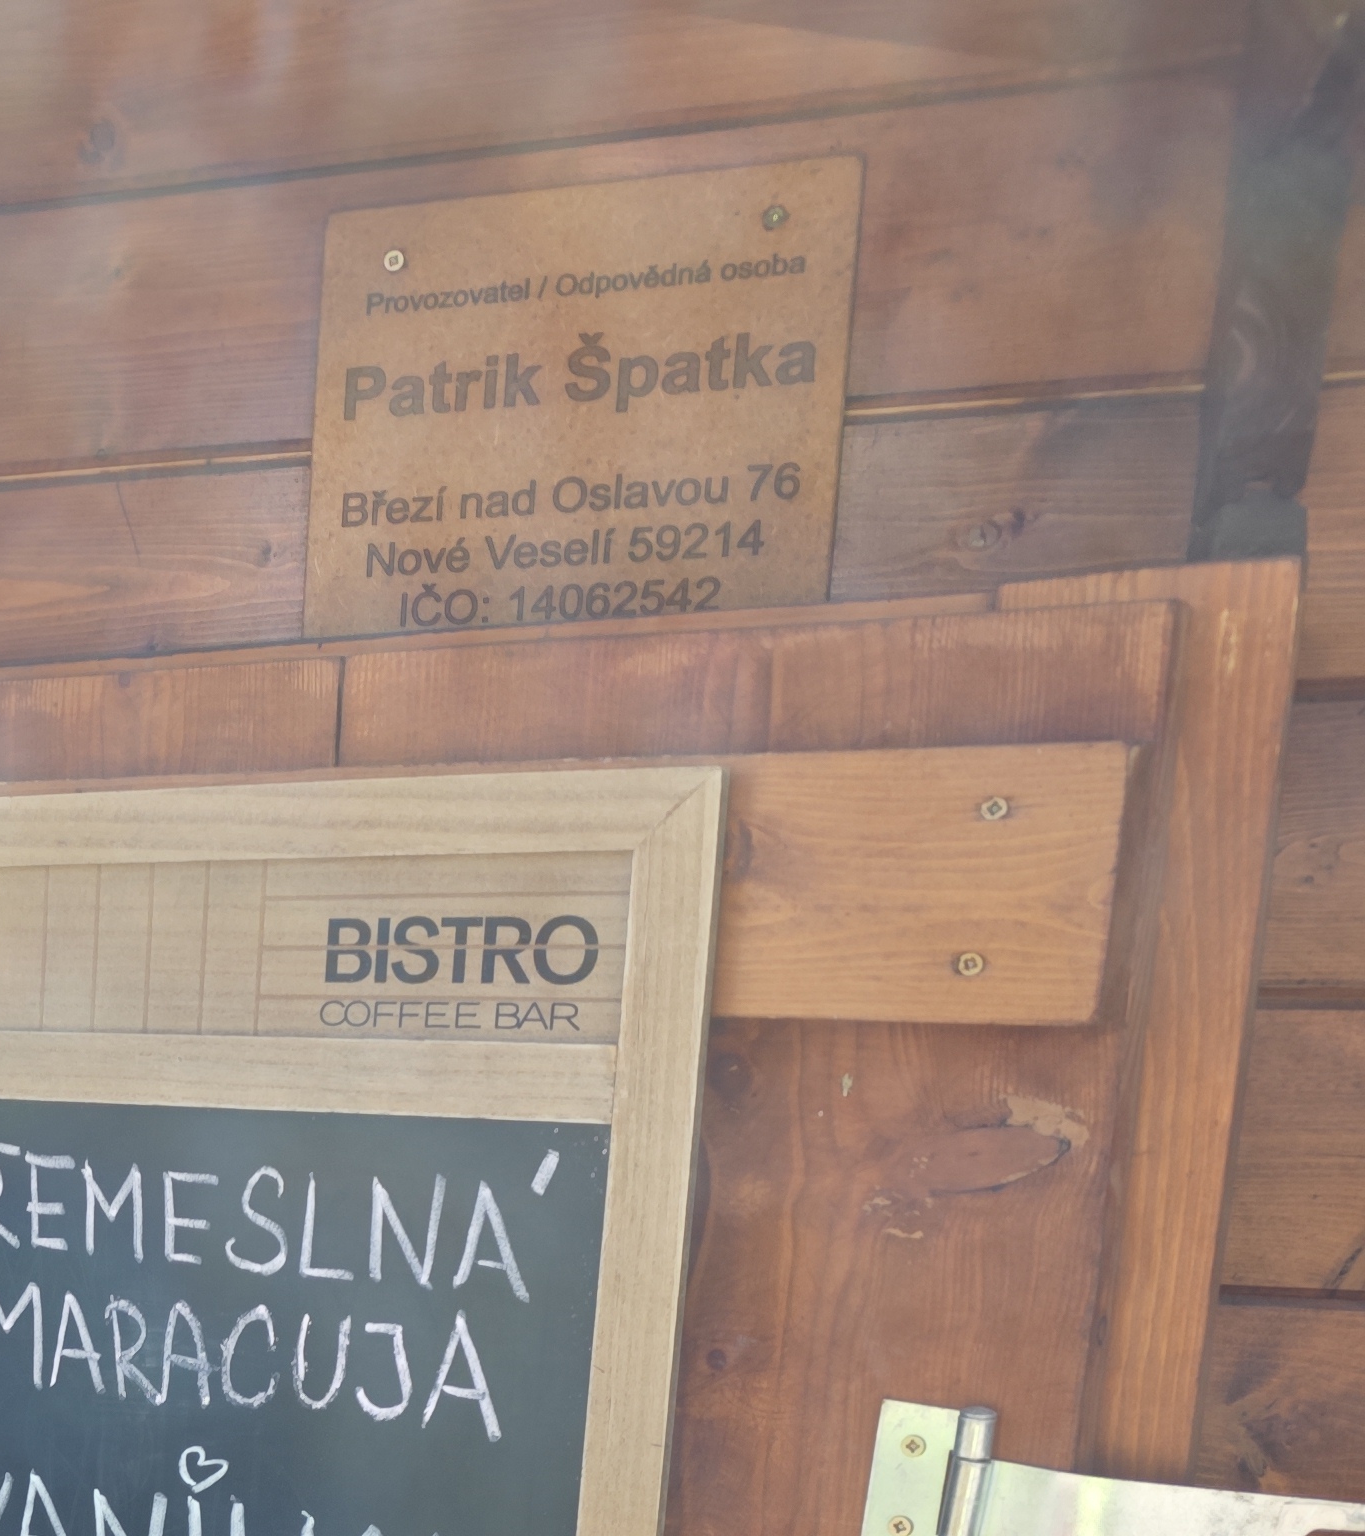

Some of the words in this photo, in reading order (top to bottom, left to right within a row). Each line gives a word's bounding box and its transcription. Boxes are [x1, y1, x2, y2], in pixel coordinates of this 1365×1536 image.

[365, 278, 531, 315] Provozovatel
[537, 275, 548, 300] /
[555, 259, 712, 299] Odpovědná
[720, 253, 806, 282] osoba
[342, 353, 542, 421] Patrik
[564, 331, 817, 412] Špatka
[341, 486, 447, 528] Březí
[460, 480, 536, 520] nad
[552, 472, 730, 515] Oslavou
[747, 461, 801, 501] 76
[366, 537, 470, 579] Nové
[485, 527, 616, 571] Veselí
[628, 519, 766, 562] 59214
[400, 582, 490, 628] IČO:
[511, 576, 722, 623] 14062542
[324, 914, 599, 986] BISTRO
[318, 999, 480, 1030] COFFEE
[494, 1002, 581, 1032] BAR
